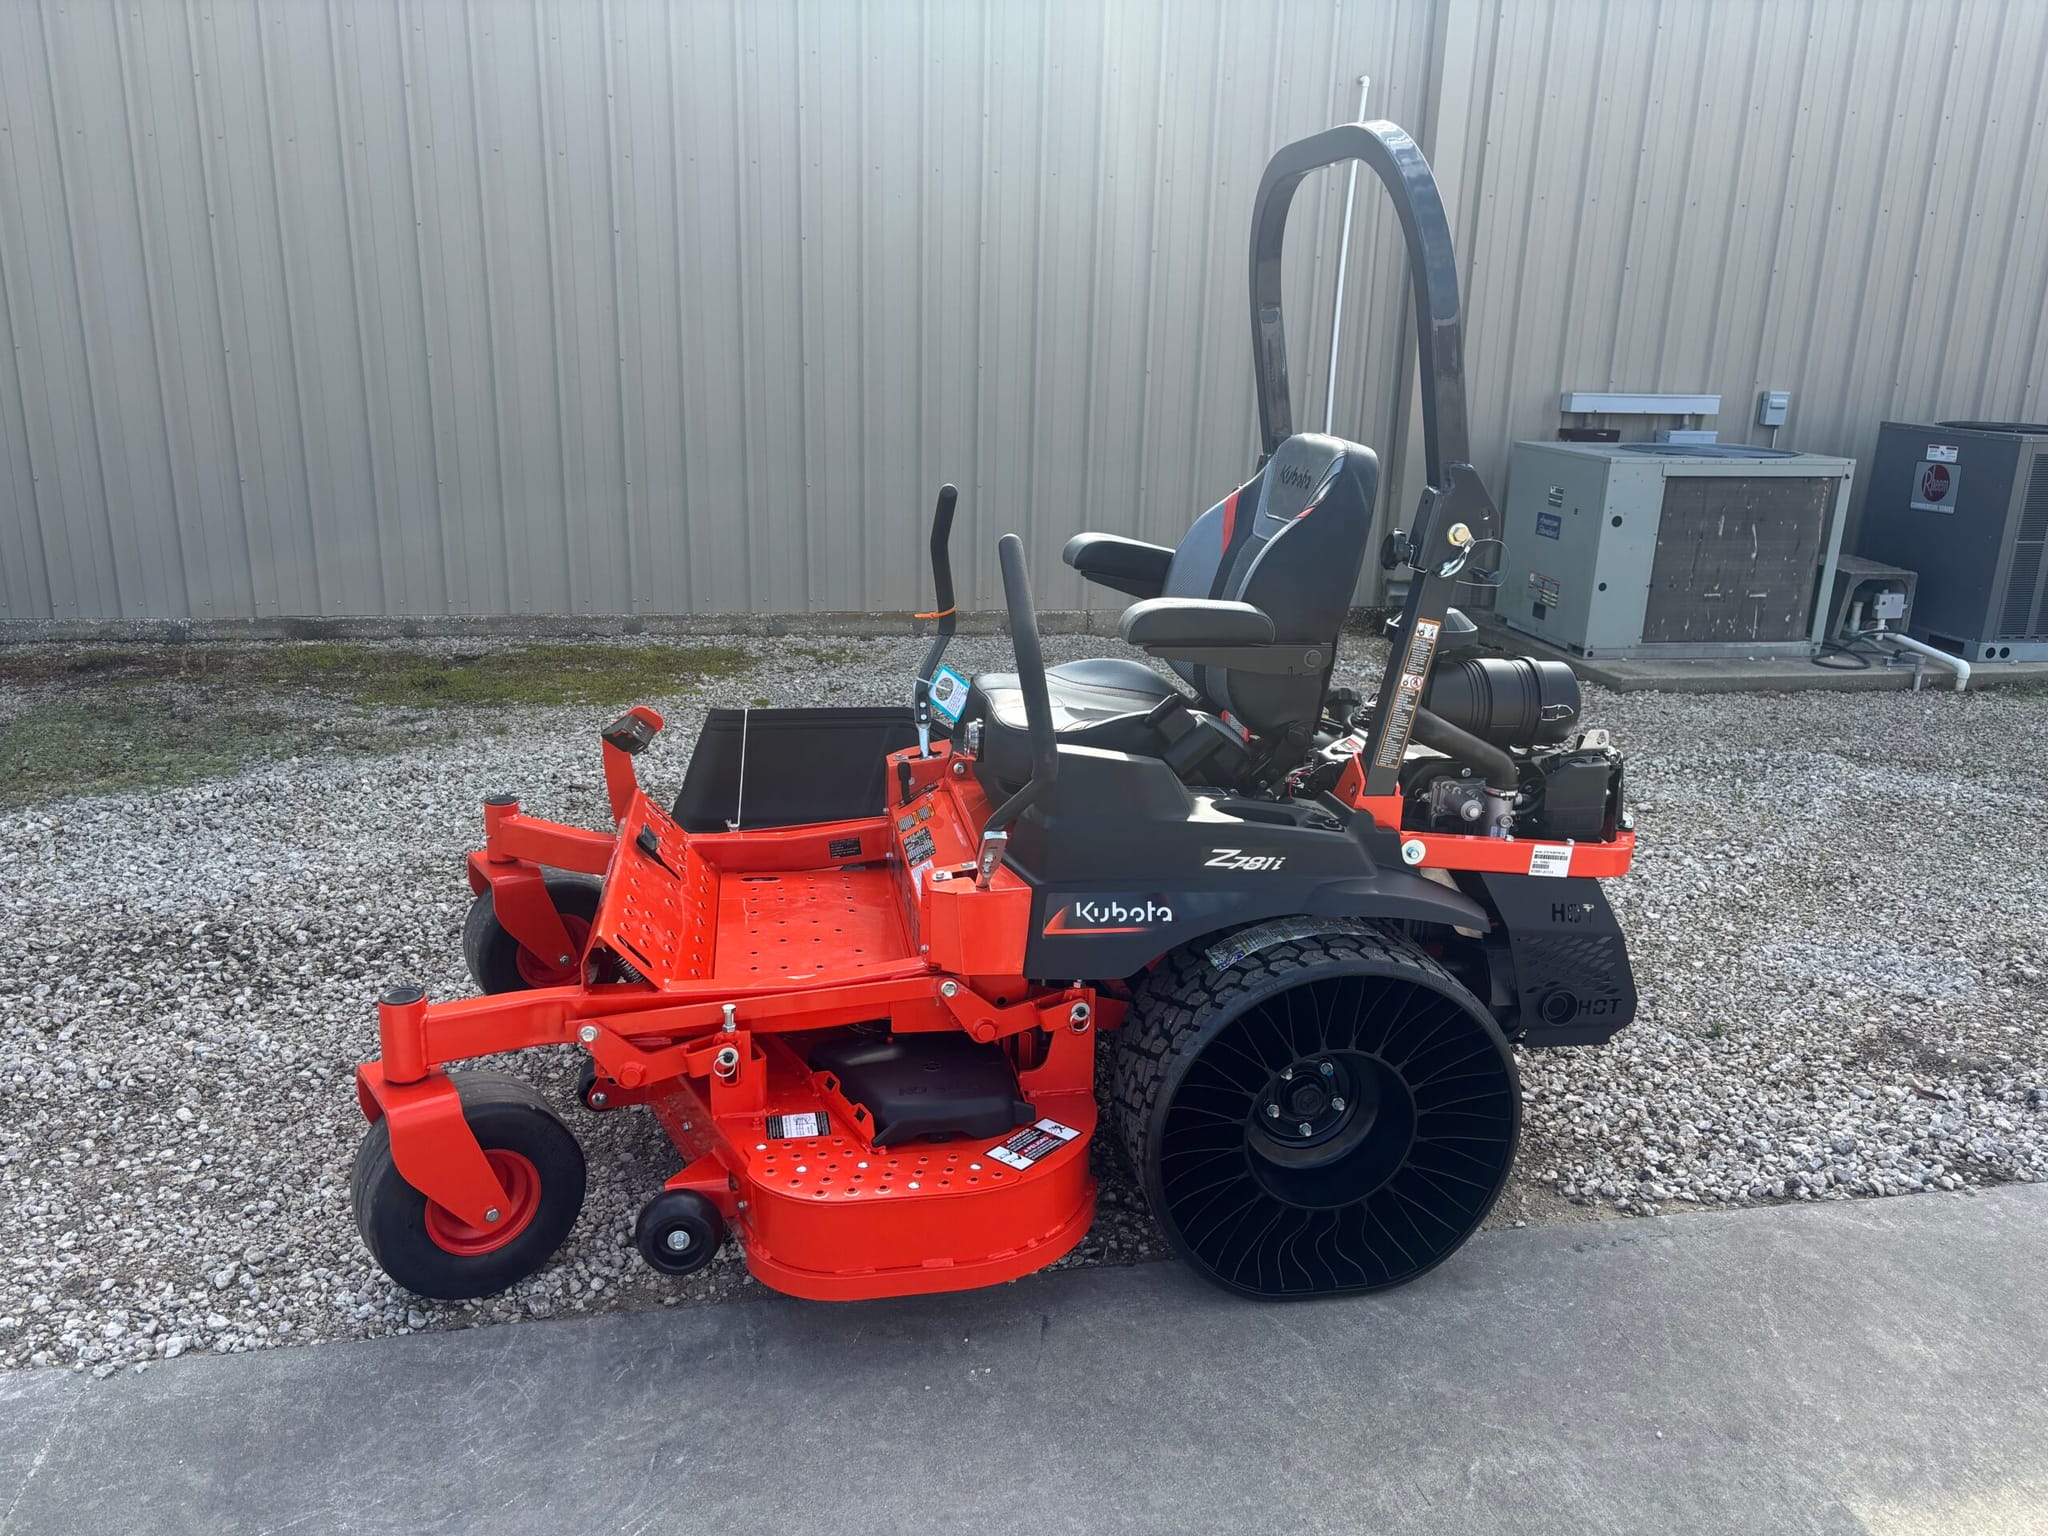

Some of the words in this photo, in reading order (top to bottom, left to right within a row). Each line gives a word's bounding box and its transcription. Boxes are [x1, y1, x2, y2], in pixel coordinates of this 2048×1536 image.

[1280, 464, 1312, 490] Kubota
[1204, 849, 1286, 871] Z781i
[1076, 901, 1173, 922] Kubota
[1551, 903, 1595, 923] HOT
[1578, 998, 1623, 1017] HOT
